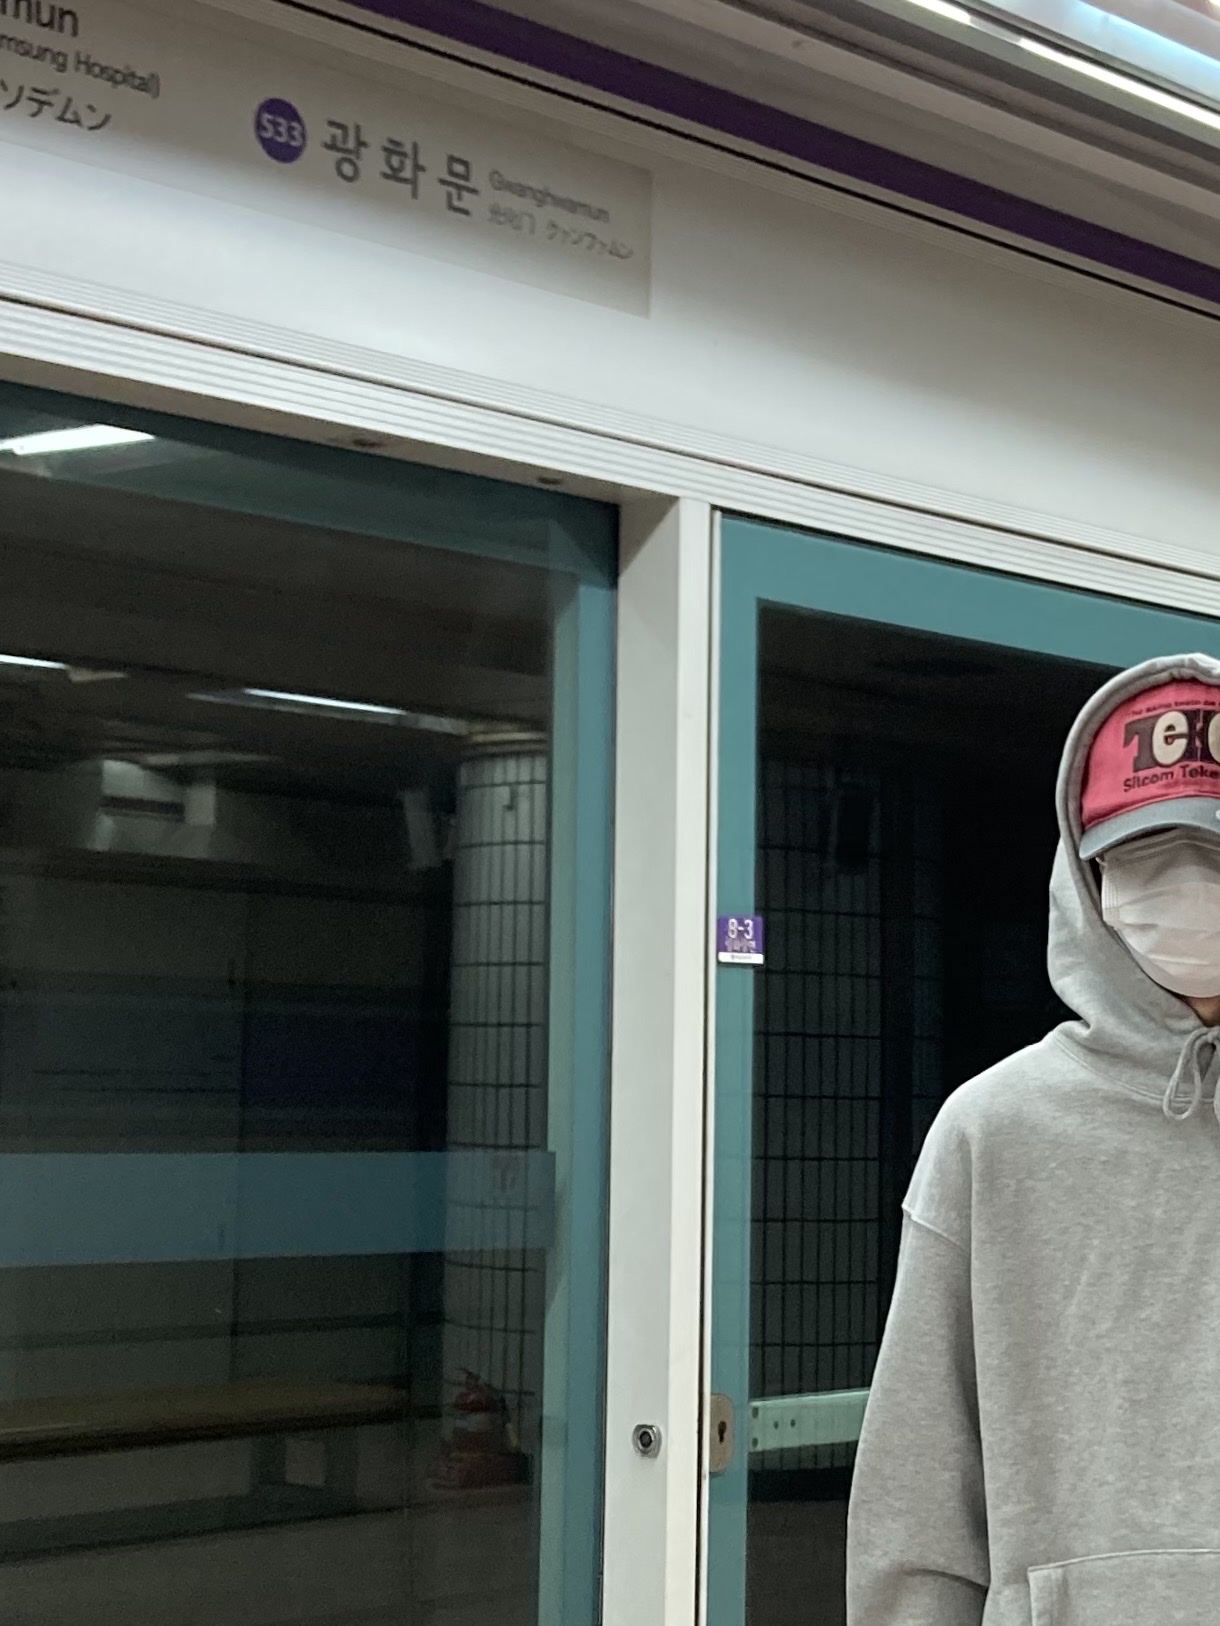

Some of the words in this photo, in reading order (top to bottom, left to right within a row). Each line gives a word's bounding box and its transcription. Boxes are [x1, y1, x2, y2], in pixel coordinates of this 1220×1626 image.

[258, 113, 304, 147] 533
[321, 118, 480, 216] 광화문
[1123, 769, 1174, 792] Sitcom
[727, 917, 754, 940] 8-3
